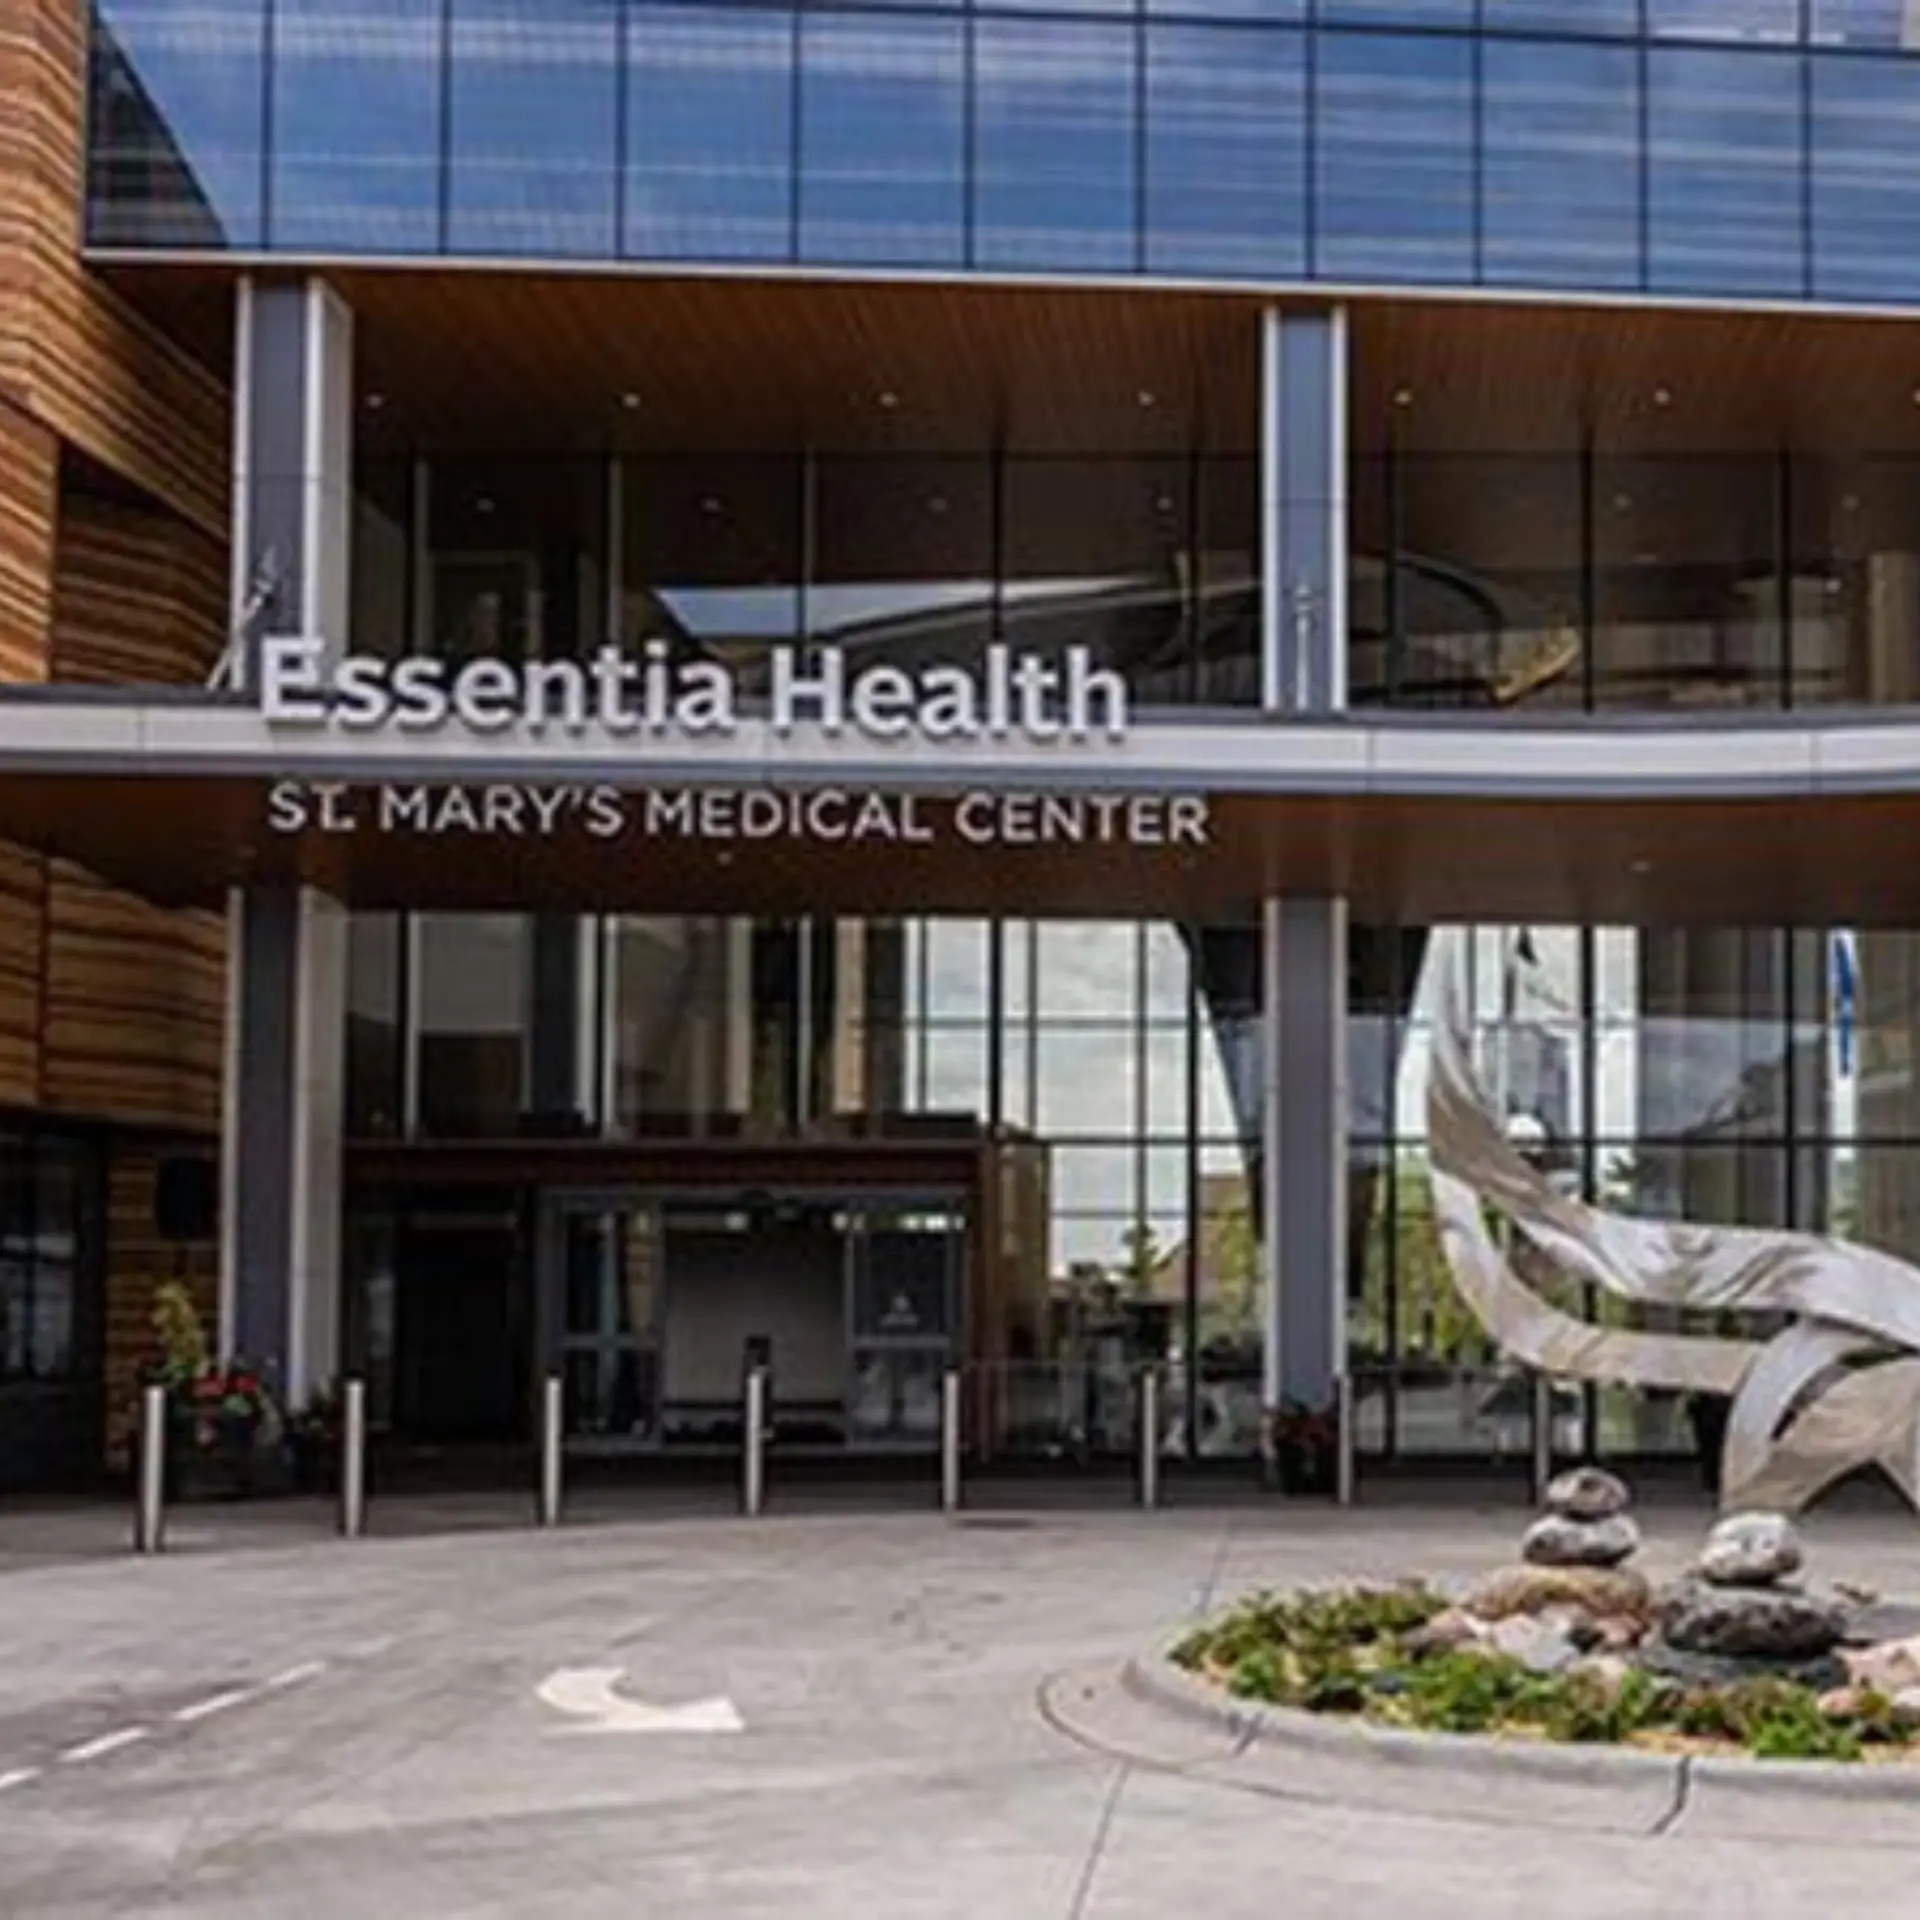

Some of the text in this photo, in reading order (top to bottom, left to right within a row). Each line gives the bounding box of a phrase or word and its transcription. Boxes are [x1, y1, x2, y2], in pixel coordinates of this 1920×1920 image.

[260, 636, 1128, 738] Essentia Health
[268, 782, 1211, 844] ST. MARY'S MEDICAL CENTER
